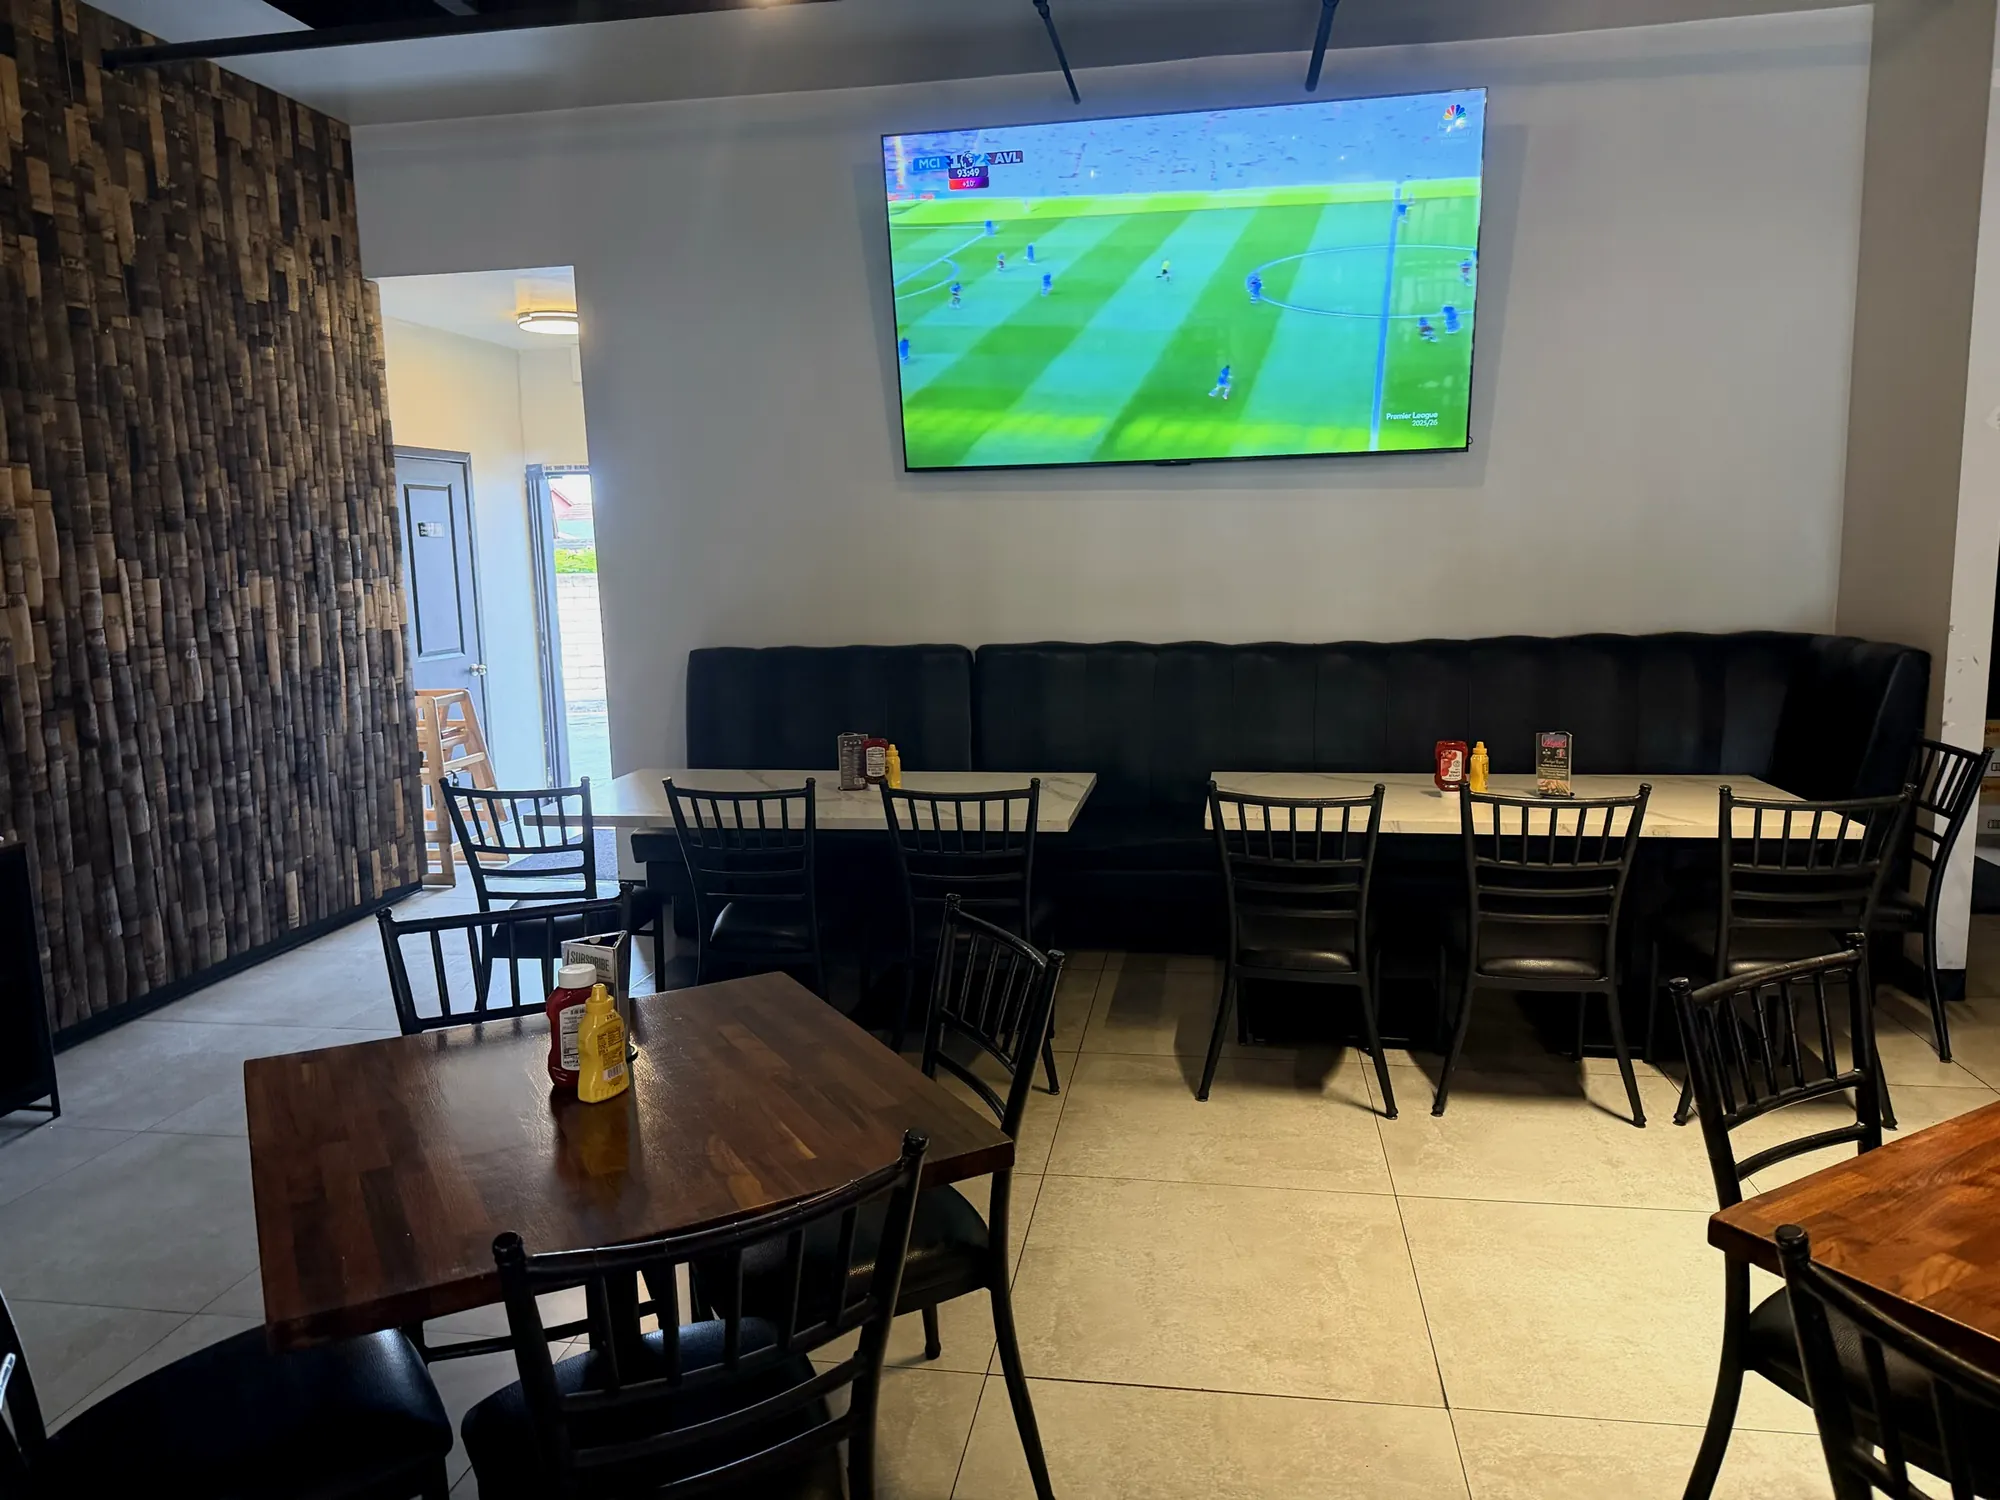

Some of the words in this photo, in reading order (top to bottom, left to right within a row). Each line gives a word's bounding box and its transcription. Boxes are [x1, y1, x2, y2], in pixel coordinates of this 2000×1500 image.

[918, 157, 941, 170] MCI
[950, 154, 961, 169] 1
[994, 151, 1021, 165] AVL
[956, 167, 980, 178] 93:49
[1386, 412, 1412, 421] Premier
[1412, 411, 1439, 420] League
